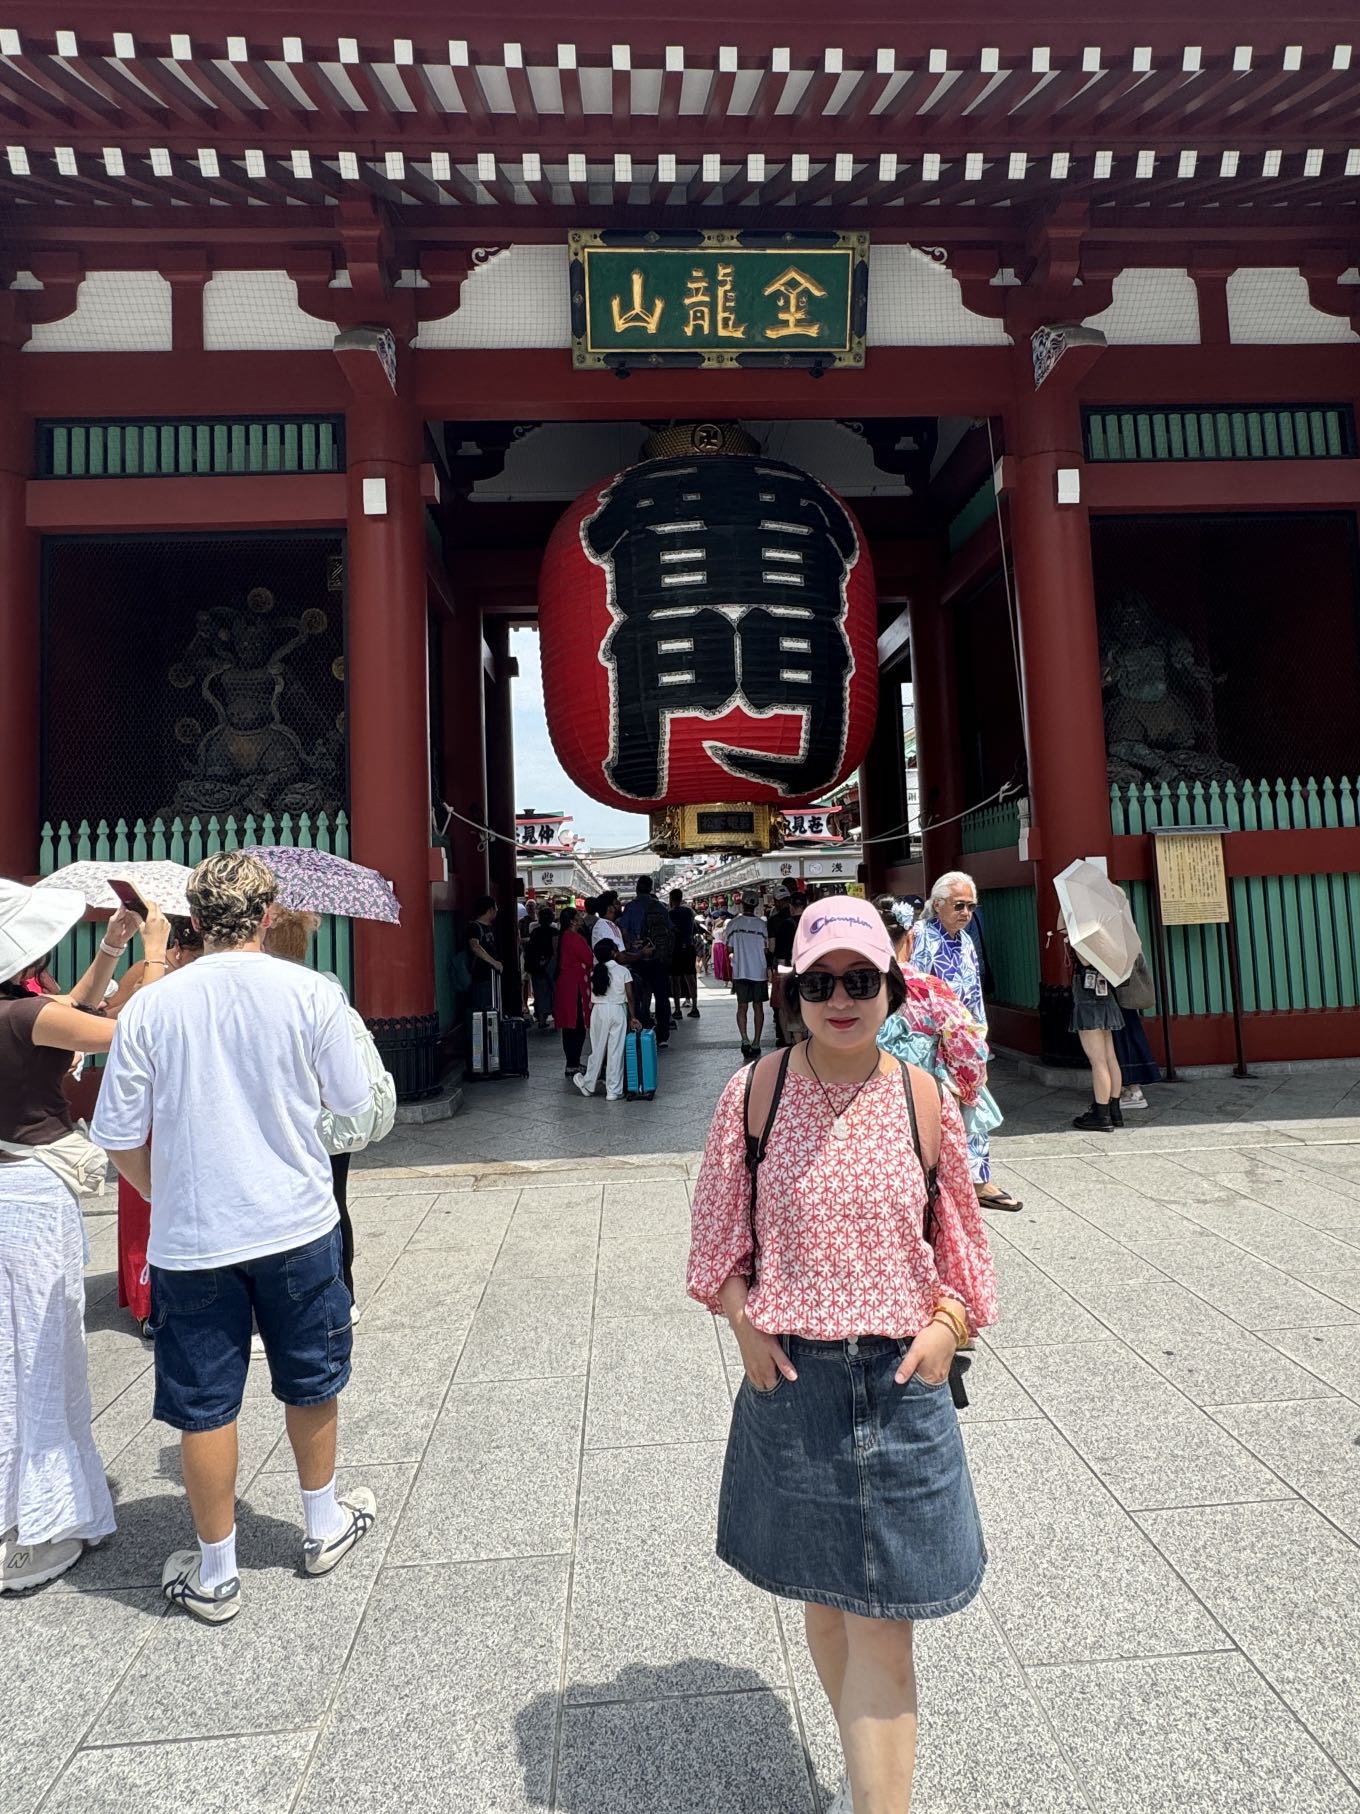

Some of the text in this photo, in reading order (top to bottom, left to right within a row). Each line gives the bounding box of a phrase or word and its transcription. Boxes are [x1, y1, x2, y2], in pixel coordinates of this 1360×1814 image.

[579, 456, 860, 799] 雷門
[810, 915, 873, 934] Champion
[7, 1552, 29, 1568] N
